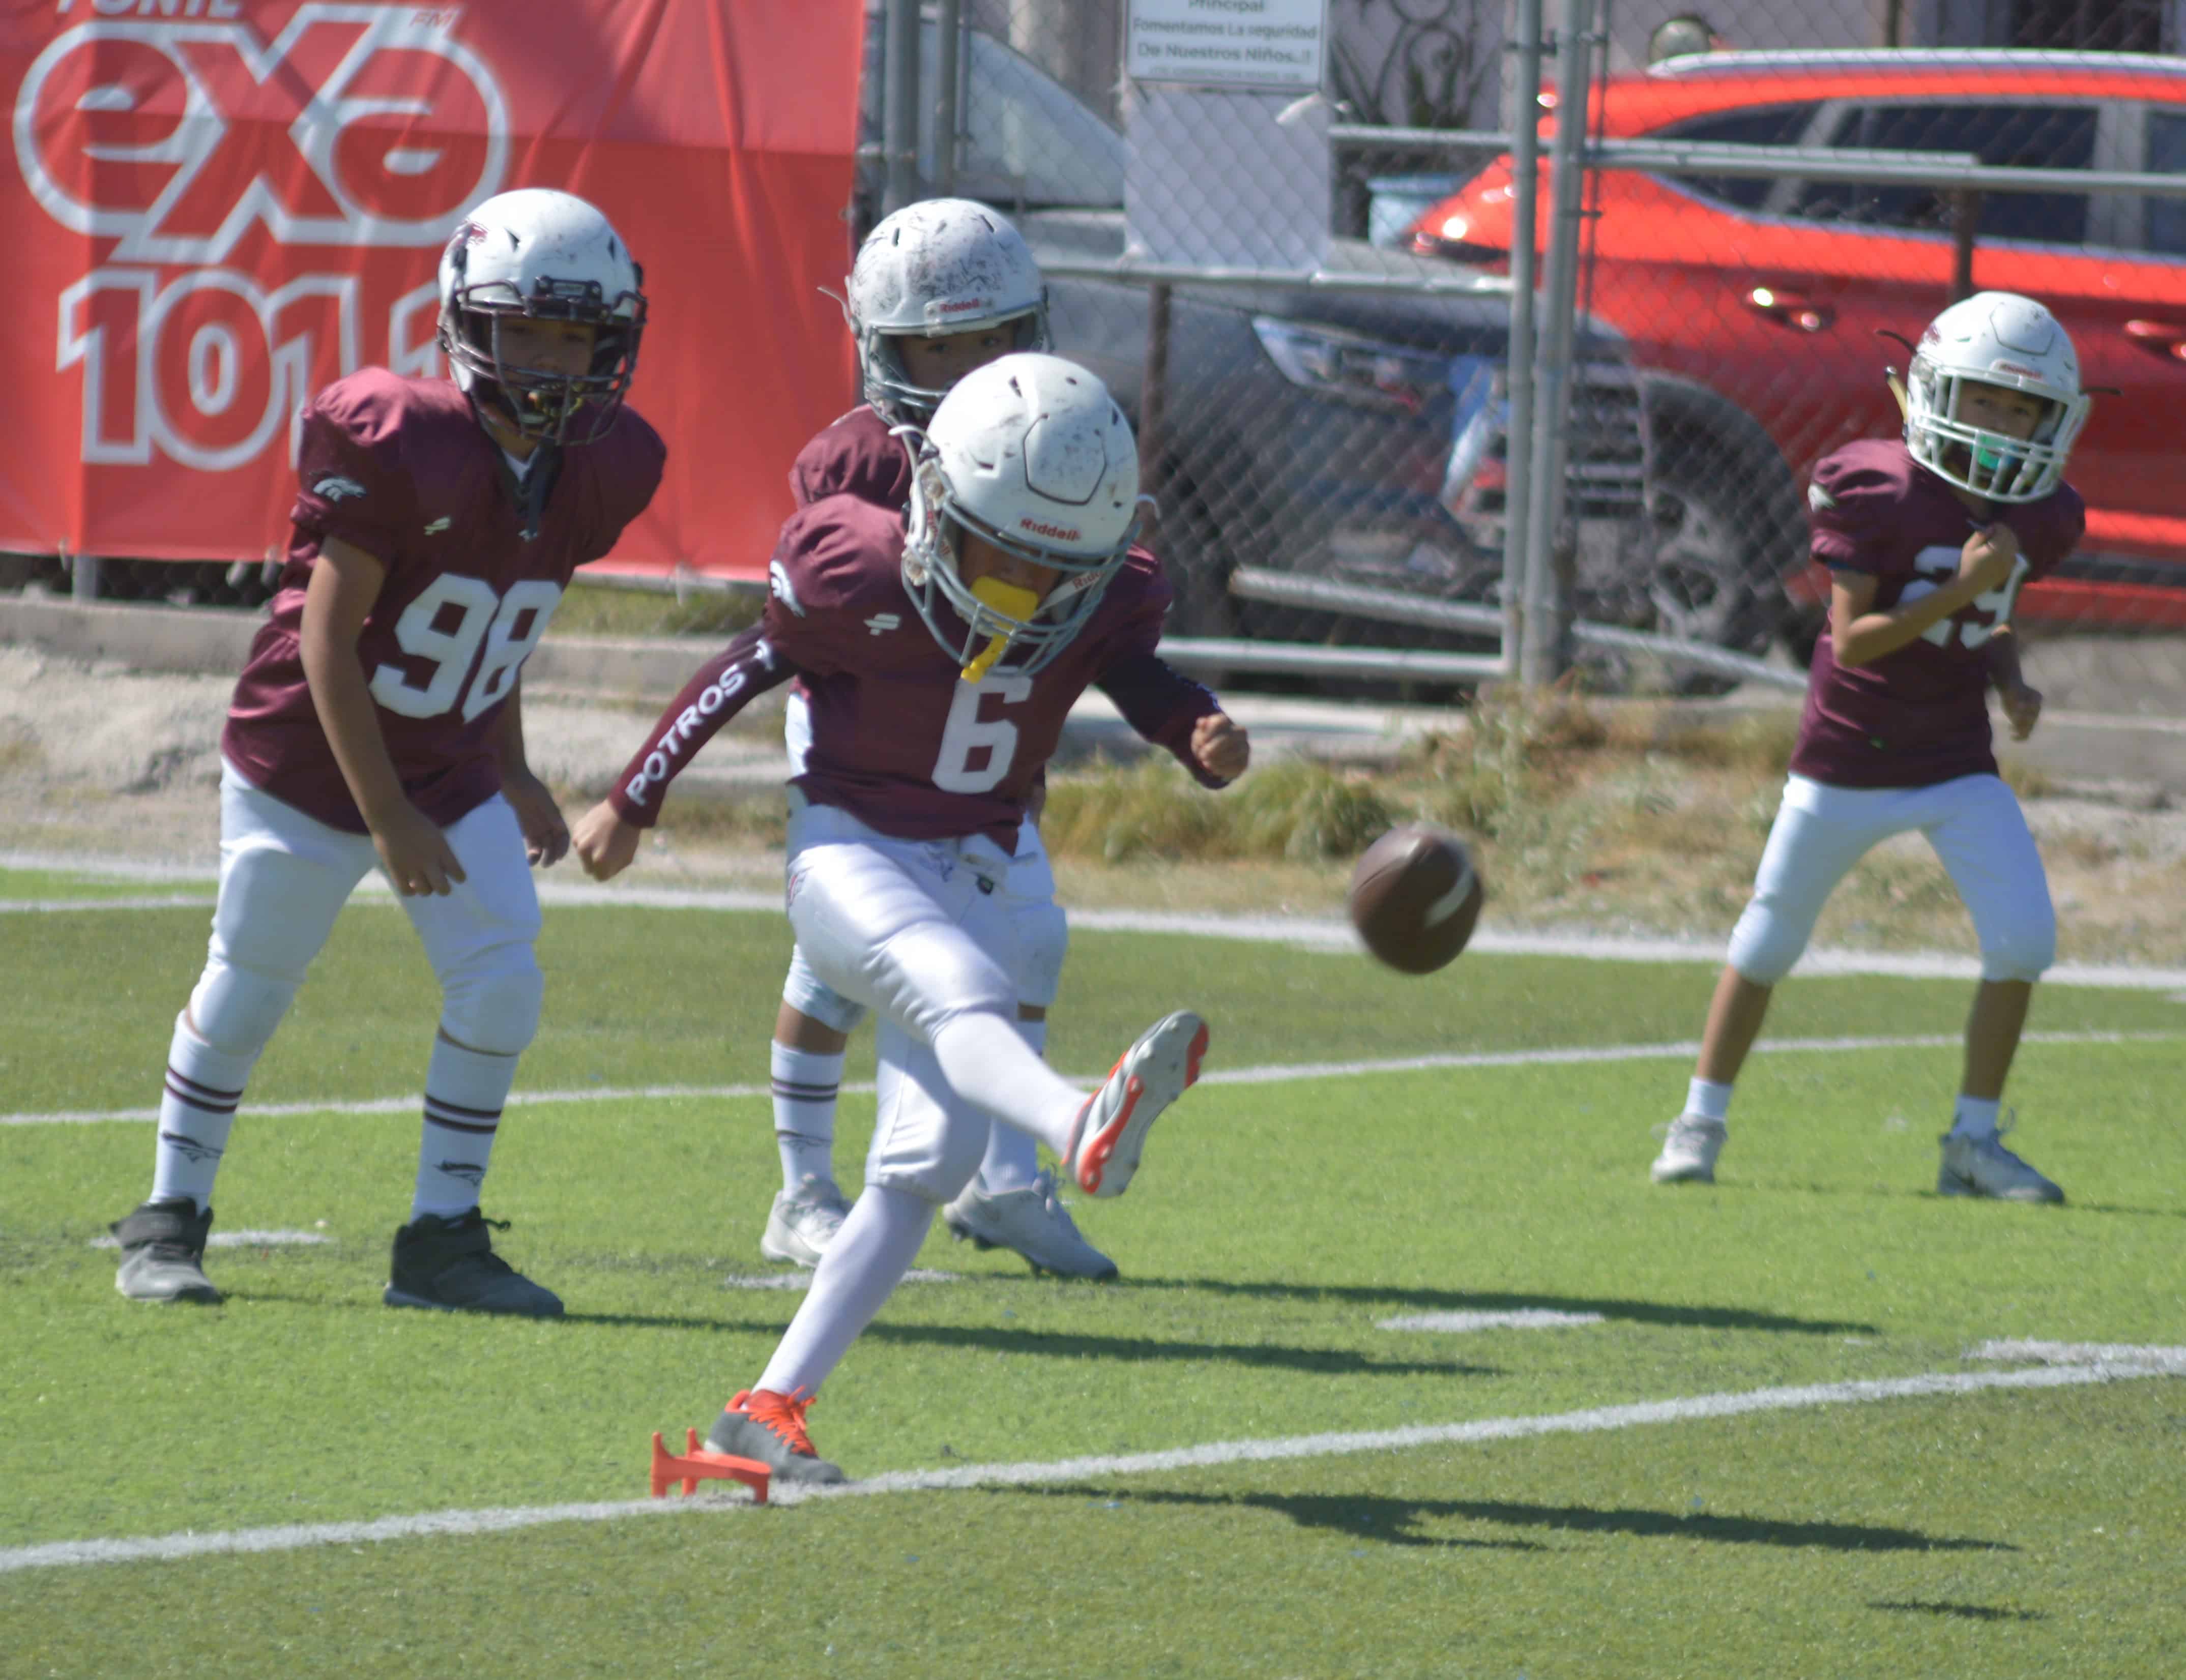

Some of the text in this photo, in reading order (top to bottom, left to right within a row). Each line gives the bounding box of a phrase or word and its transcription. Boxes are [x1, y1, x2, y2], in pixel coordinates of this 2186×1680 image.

[1134, 17, 1318, 41] Fomentamos La seguridad
[1138, 42, 1160, 57] De
[1165, 45, 1239, 61] Nuestros
[1021, 518, 1082, 542] Riddell
[368, 572, 563, 725] 98
[625, 663, 747, 808] POTROS
[931, 666, 1034, 794] 6
